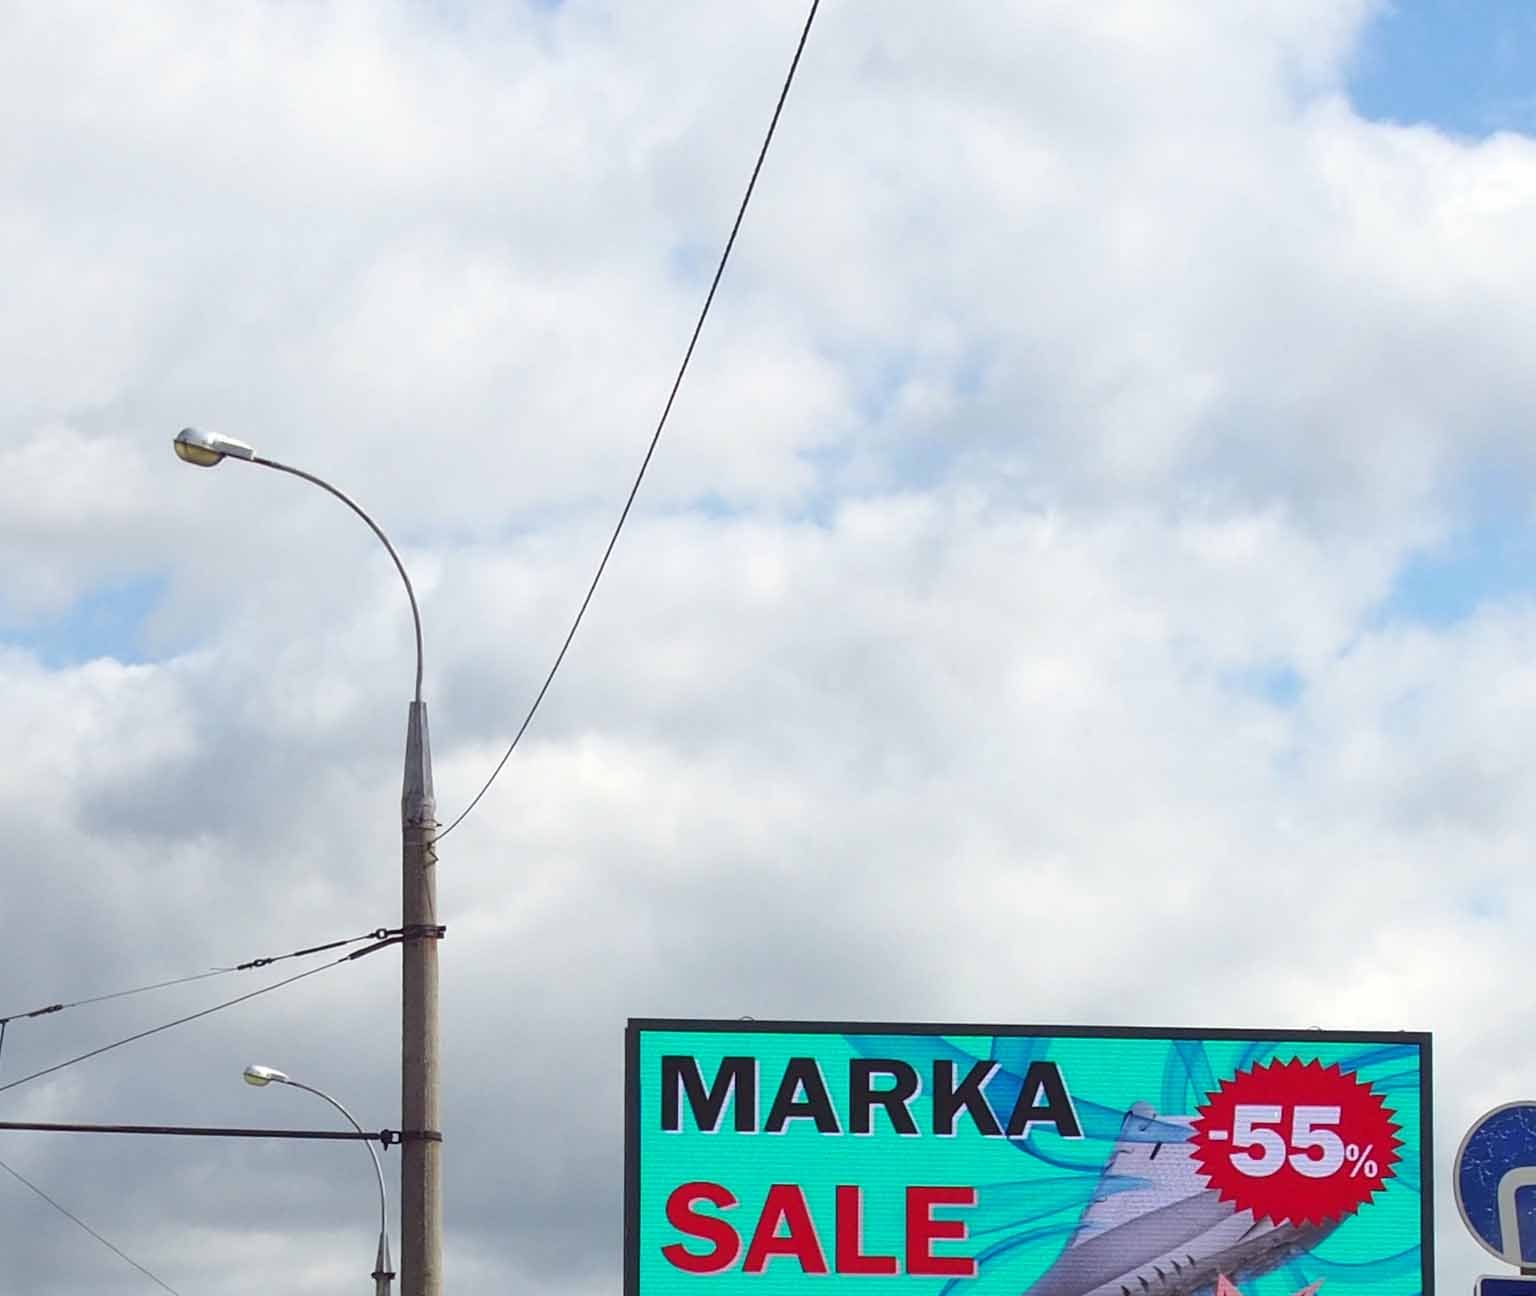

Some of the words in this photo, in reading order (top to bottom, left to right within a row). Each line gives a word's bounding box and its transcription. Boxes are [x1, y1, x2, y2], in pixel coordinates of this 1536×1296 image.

[661, 1055, 1085, 1139] MARKA
[1208, 1104, 1379, 1179] -55%
[660, 1181, 979, 1277] SALE
